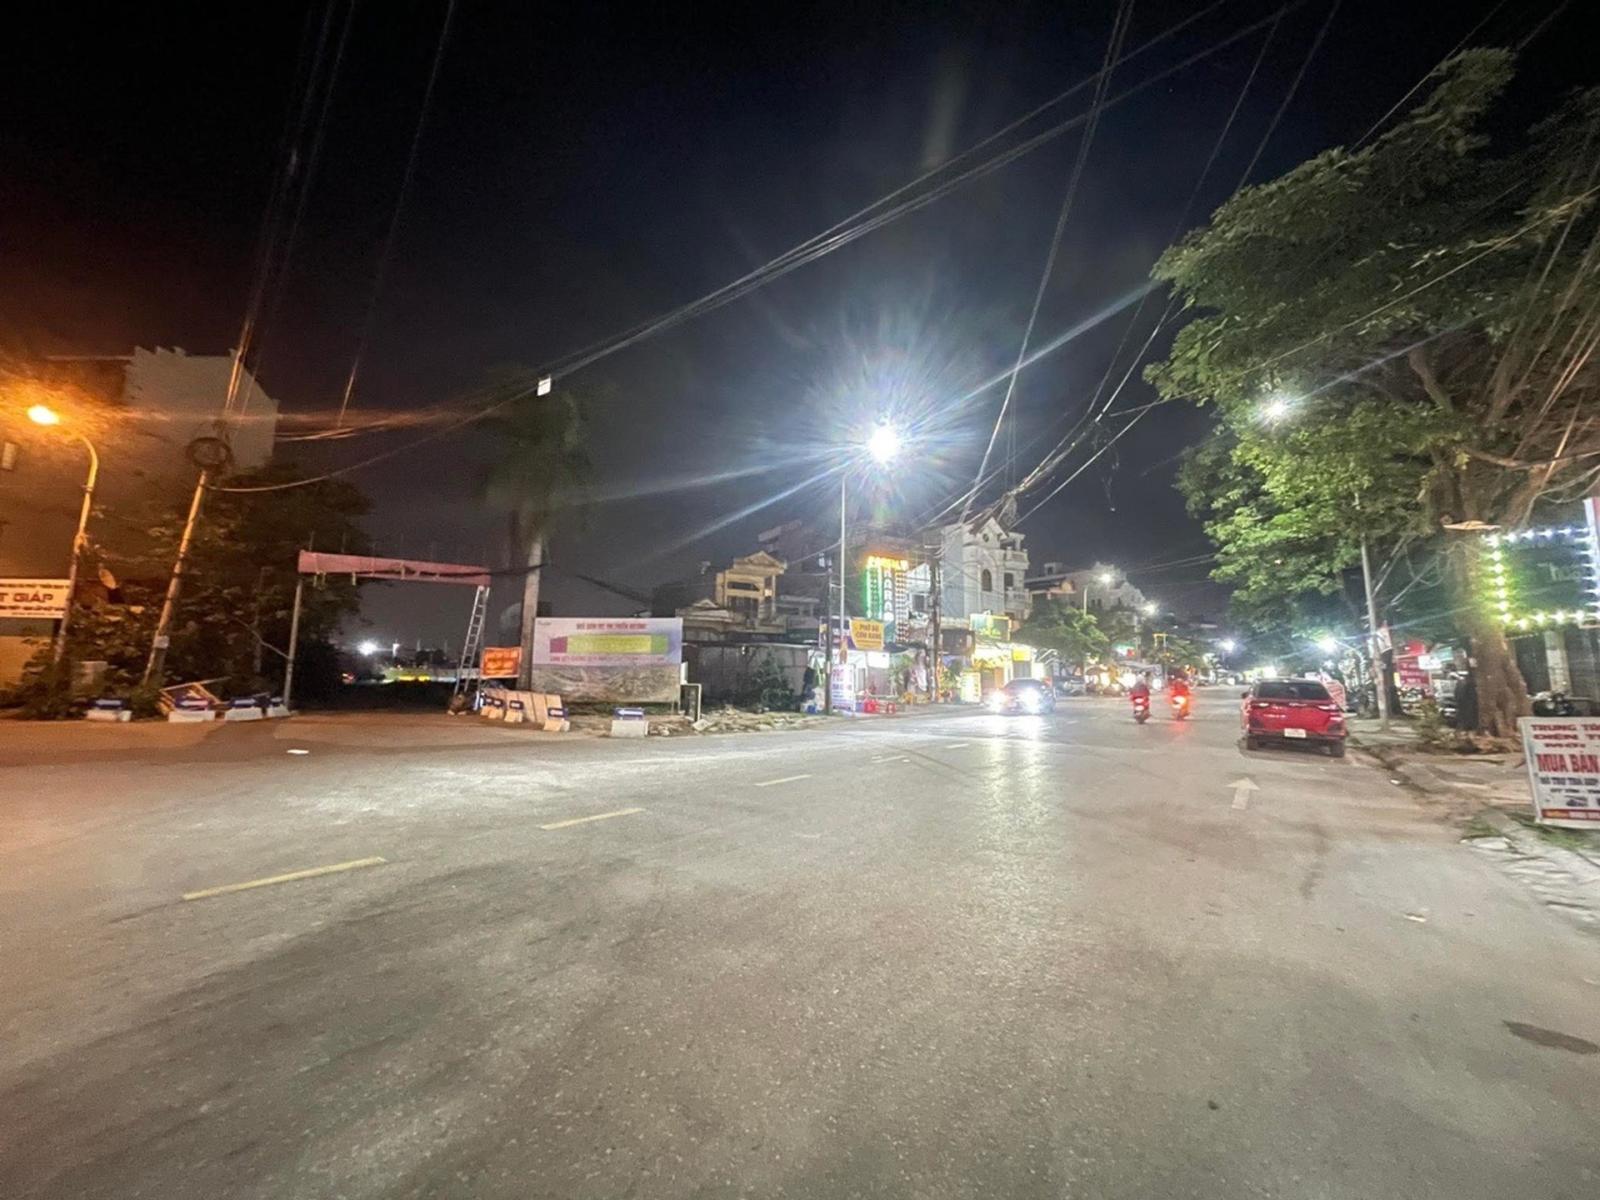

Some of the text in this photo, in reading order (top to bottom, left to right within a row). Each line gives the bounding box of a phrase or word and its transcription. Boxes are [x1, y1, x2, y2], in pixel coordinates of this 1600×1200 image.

[13, 590, 54, 603] GIÁP
[1530, 723, 1577, 731] TRUNG
[1535, 750, 1599, 773] MUA BÁN
